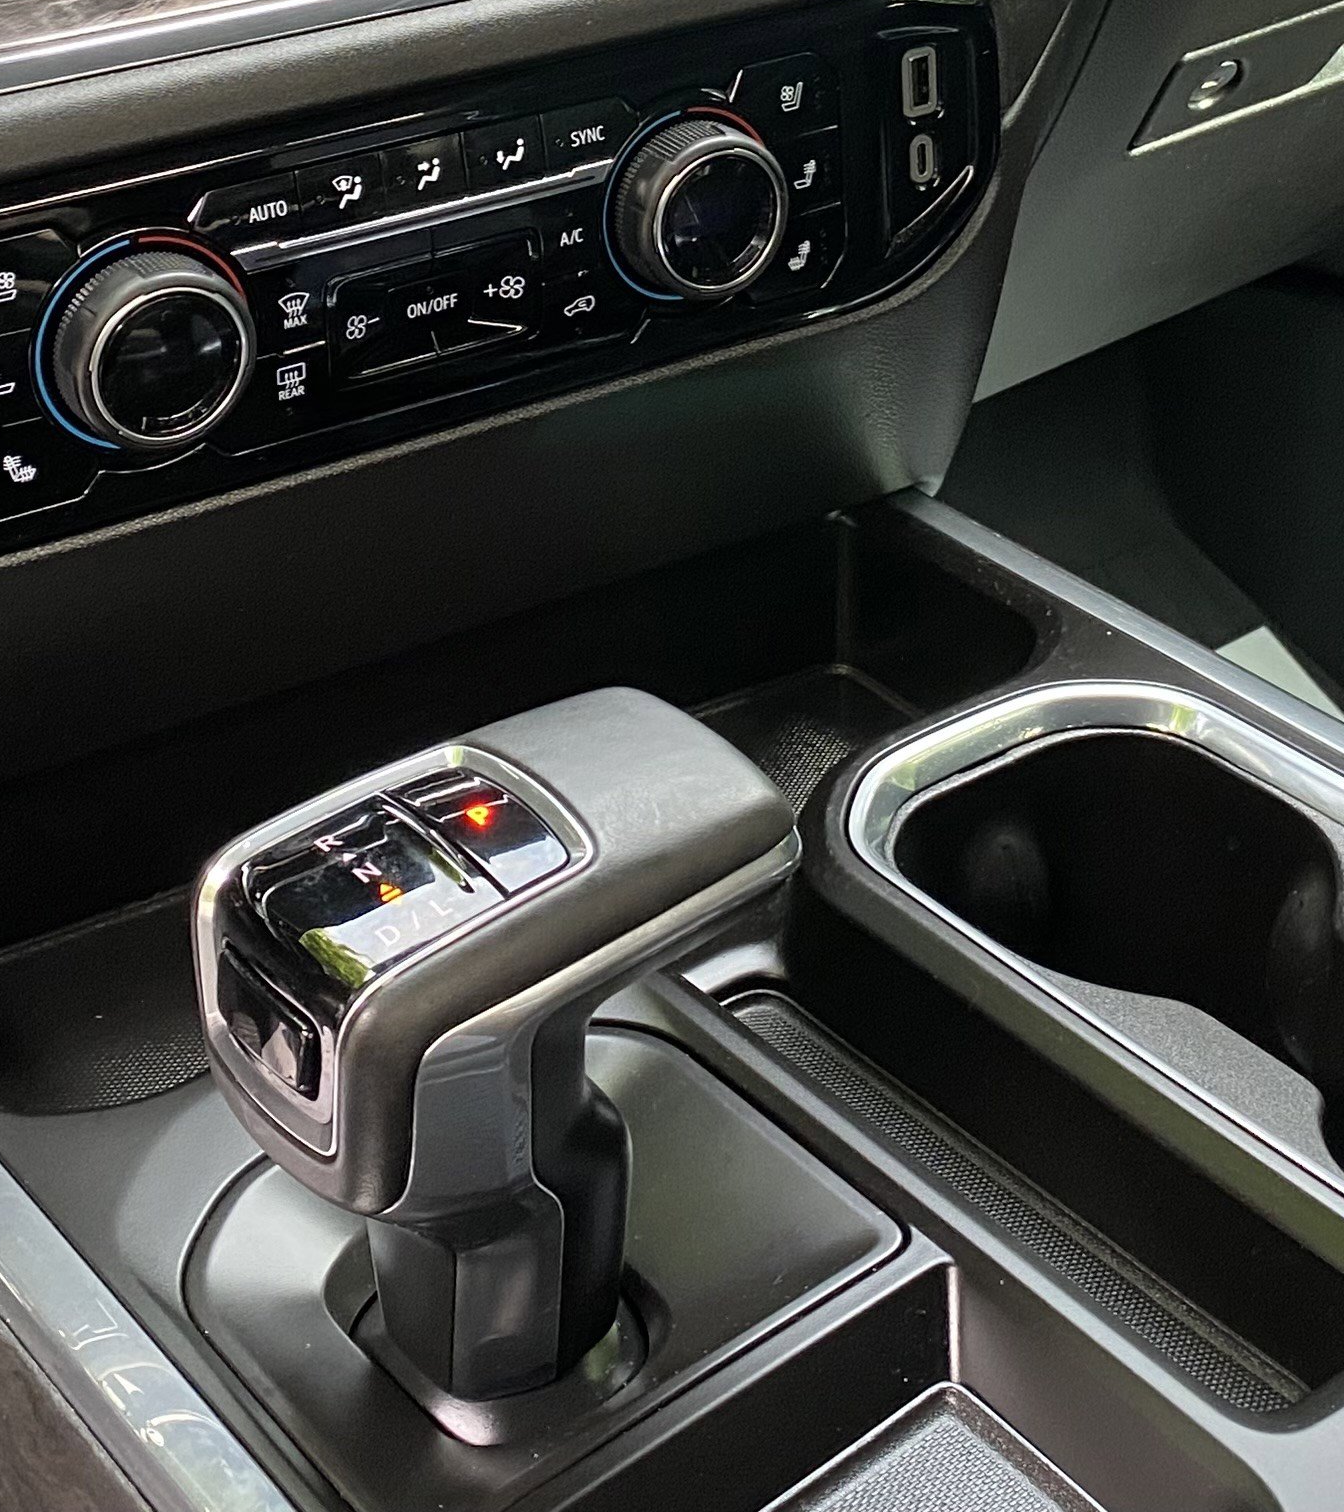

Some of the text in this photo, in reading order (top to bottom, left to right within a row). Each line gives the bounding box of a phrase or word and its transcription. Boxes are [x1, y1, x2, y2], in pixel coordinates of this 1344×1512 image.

[570, 126, 606, 148] SYNC
[248, 200, 288, 224] AUTO
[560, 228, 584, 247] A/C
[407, 293, 459, 319] ON/OFF
[283, 314, 308, 330] MAX
[277, 385, 306, 401] REAR
[465, 805, 490, 827] P
[313, 835, 344, 853] R
[351, 860, 383, 884] N
